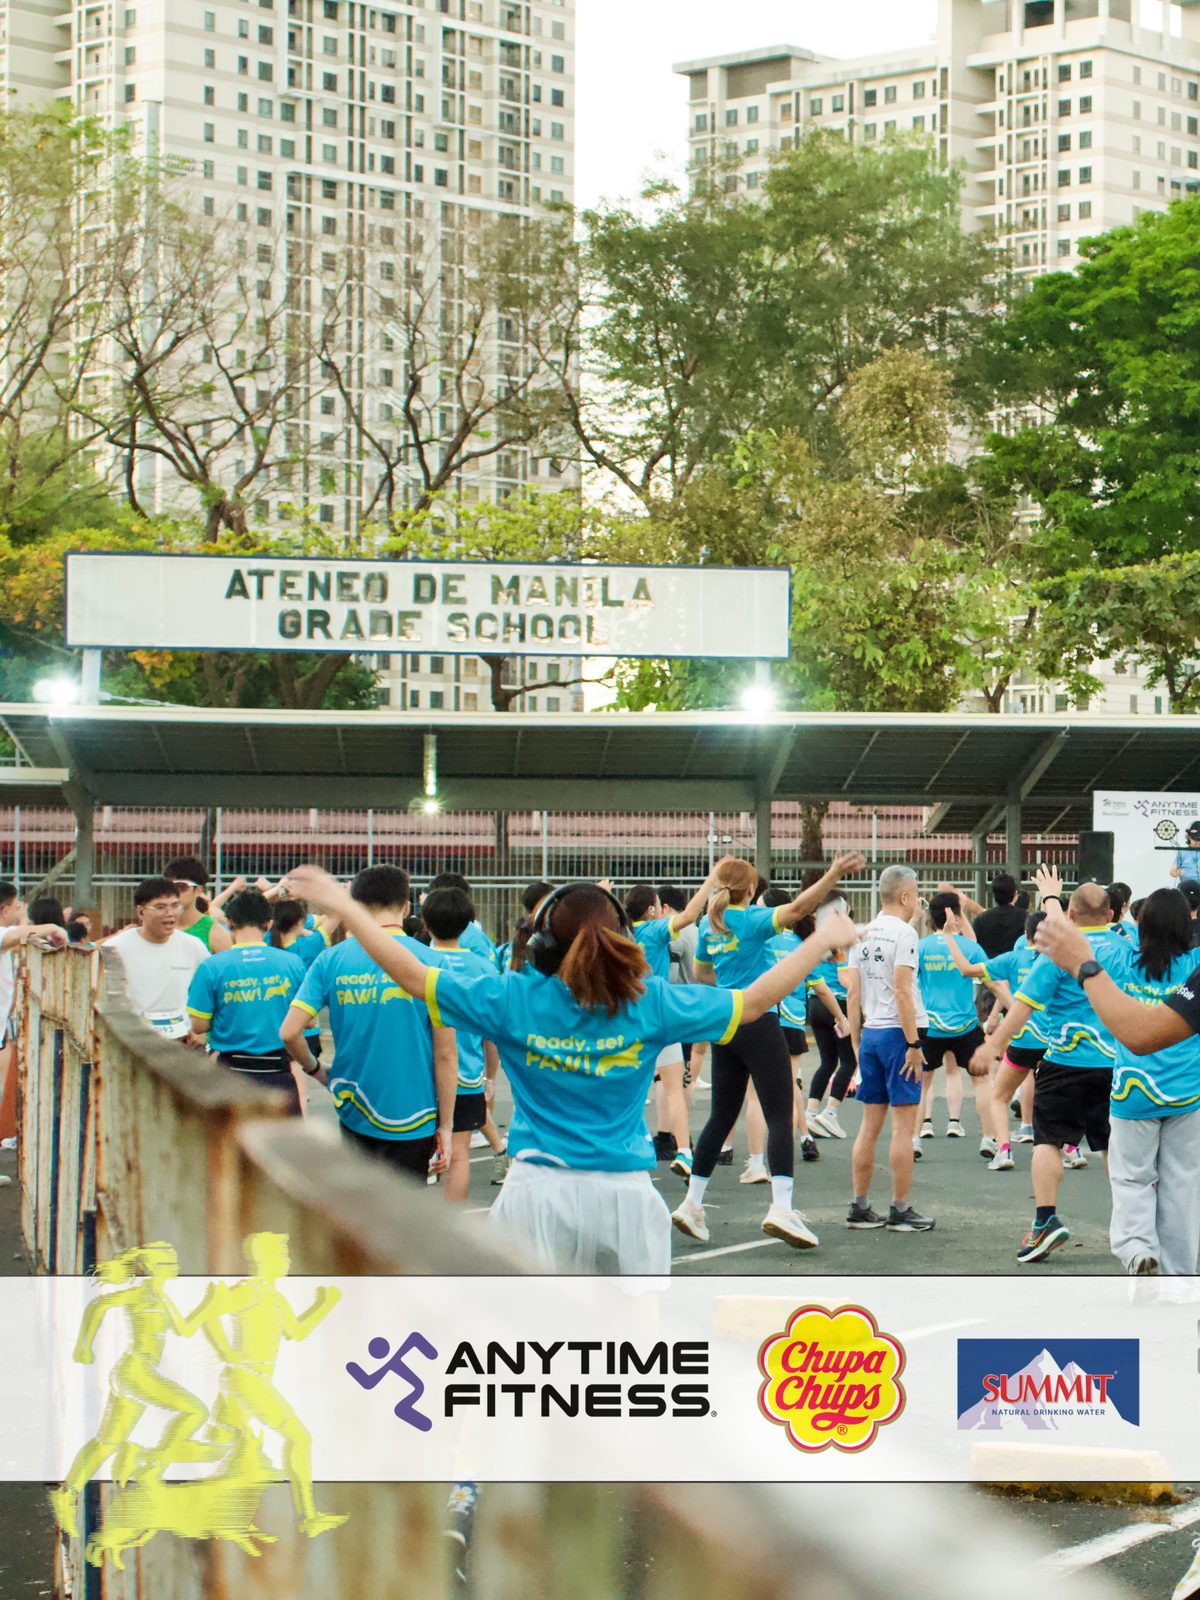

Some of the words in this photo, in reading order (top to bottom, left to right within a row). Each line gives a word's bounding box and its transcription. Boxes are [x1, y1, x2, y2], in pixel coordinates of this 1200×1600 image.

[225, 568, 389, 603] ATENEO
[412, 572, 468, 605] DE
[490, 573, 655, 609] MANILA
[277, 608, 424, 641] GRADE
[446, 611, 610, 646] SCHOOL
[1150, 808, 1198, 816] FITNESS
[1151, 801, 1198, 809] ANYTIME
[223, 988, 262, 1005] PAW!
[336, 987, 377, 1005] PAW!
